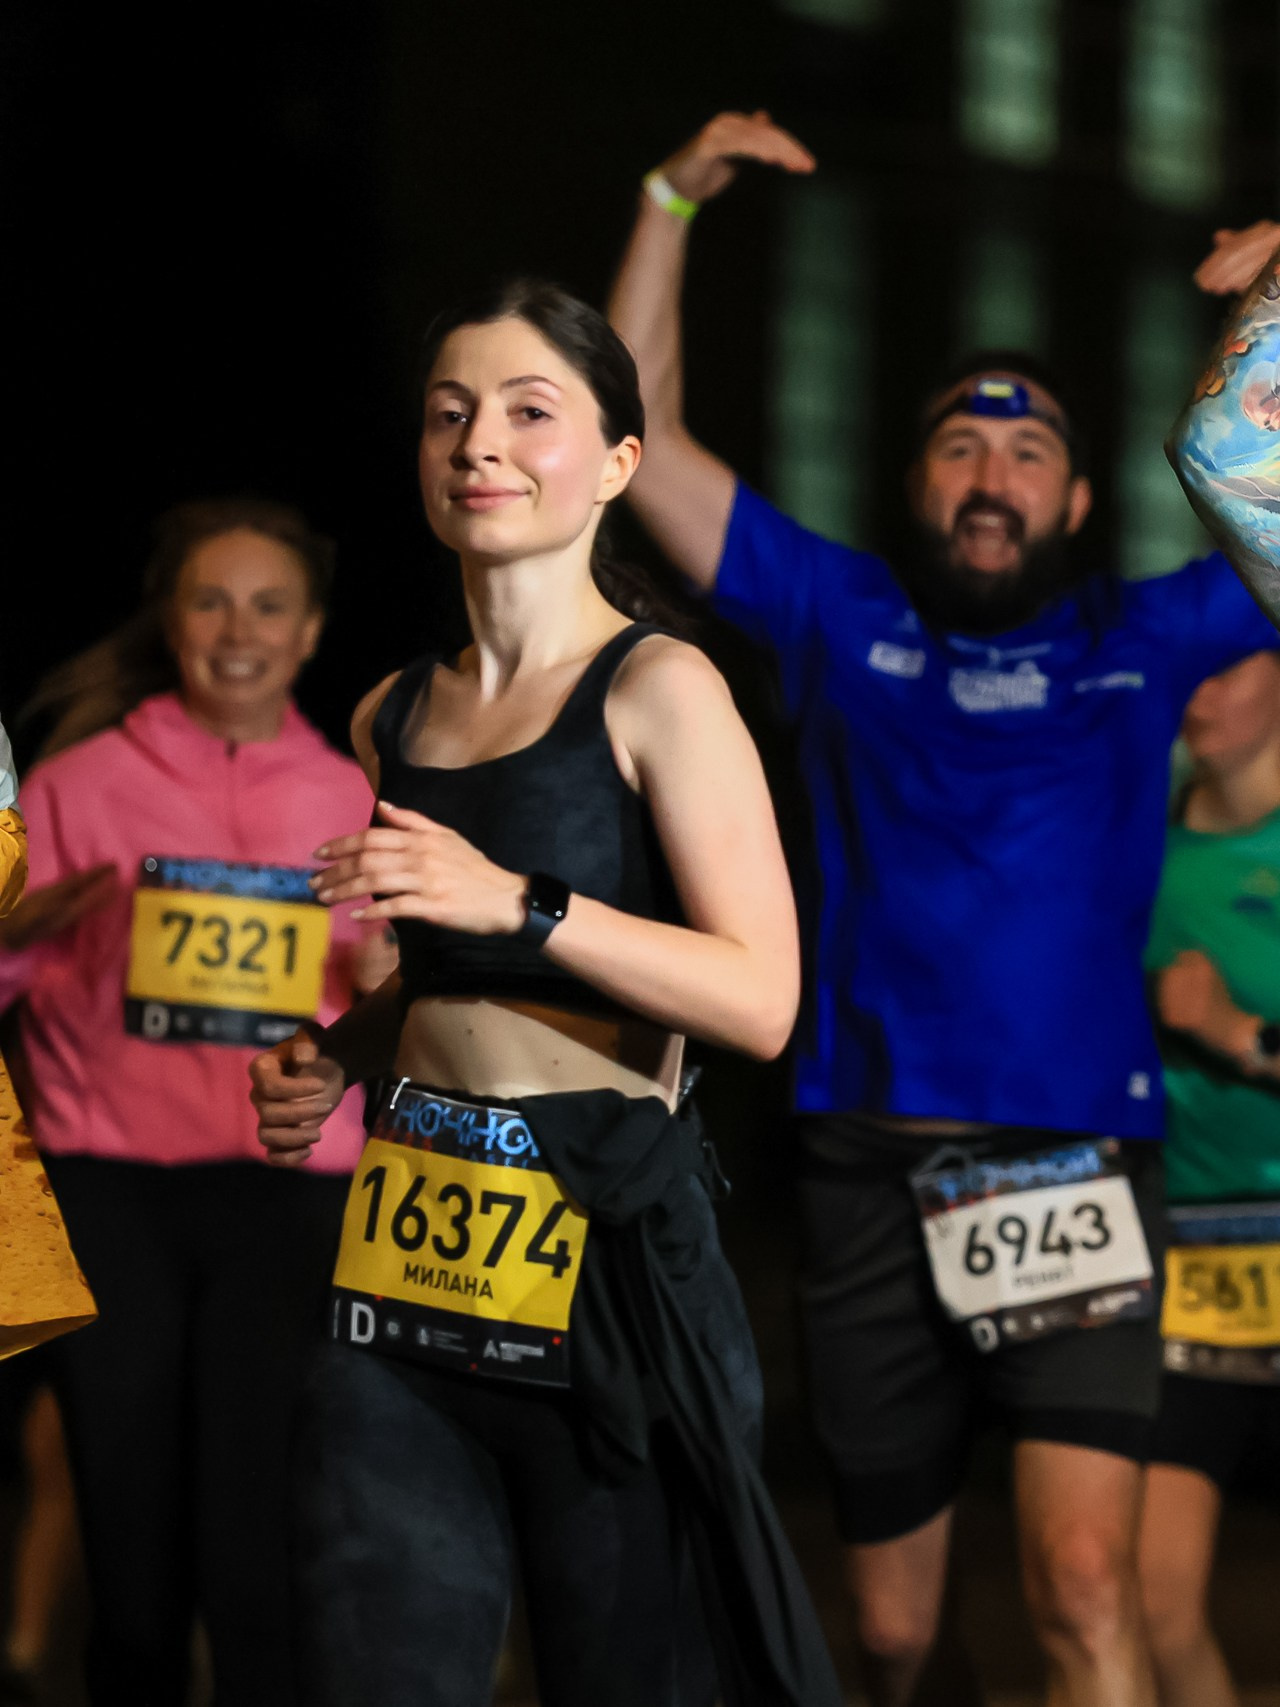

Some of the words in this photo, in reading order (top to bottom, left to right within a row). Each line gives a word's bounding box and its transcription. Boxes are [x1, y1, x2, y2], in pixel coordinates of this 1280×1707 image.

[160, 910, 298, 977] 7321
[142, 1003, 171, 1038] D
[361, 1165, 572, 1279] 16374
[963, 1201, 1112, 1277] 6943
[403, 1261, 494, 1301] МИЛАНА
[350, 1301, 376, 1344] D
